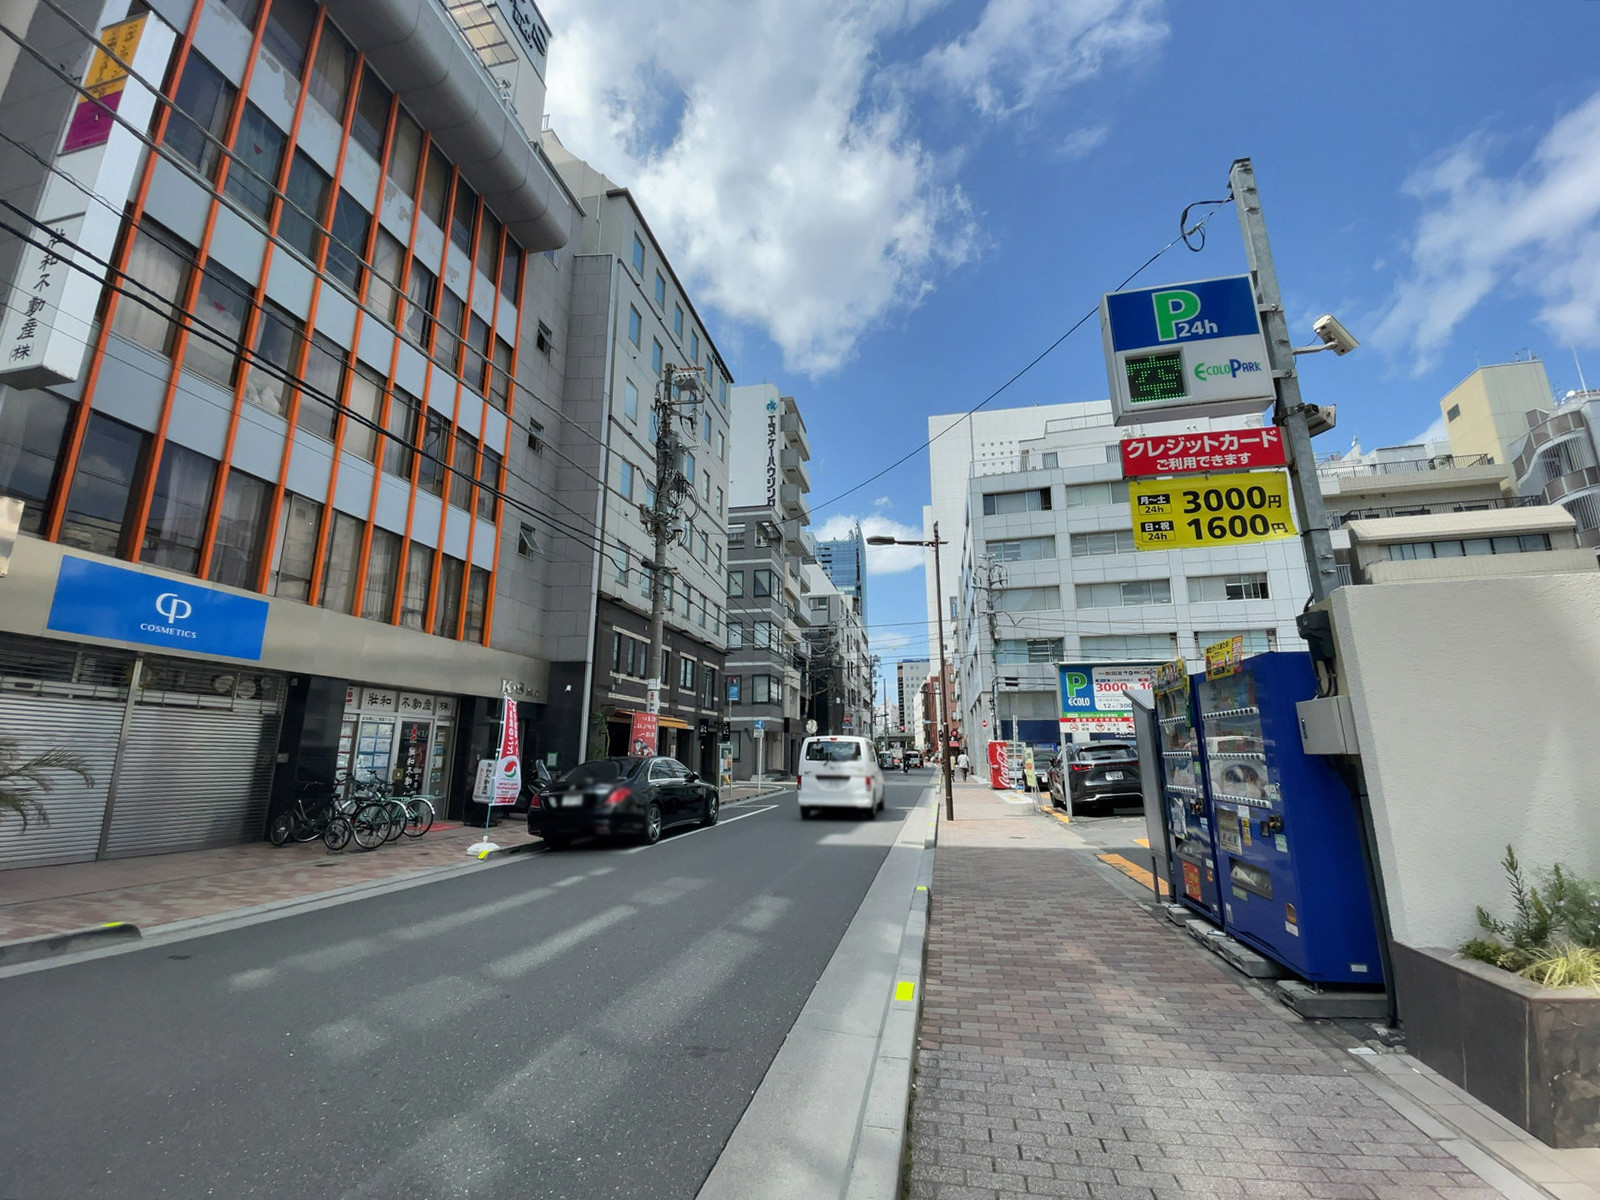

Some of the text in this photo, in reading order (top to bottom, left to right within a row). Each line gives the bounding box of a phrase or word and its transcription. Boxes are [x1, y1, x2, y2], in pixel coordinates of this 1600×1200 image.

[1152, 289, 1202, 342] P
[1178, 319, 1218, 338] 24h
[1126, 430, 1278, 458] クレジットカード
[1156, 452, 1252, 470] ご利用できます
[1145, 504, 1164, 514] 24h
[1148, 532, 1168, 541] 24h
[140, 622, 197, 638] COSMETICS
[1066, 672, 1088, 698] P
[1068, 698, 1090, 706] ECOLO
